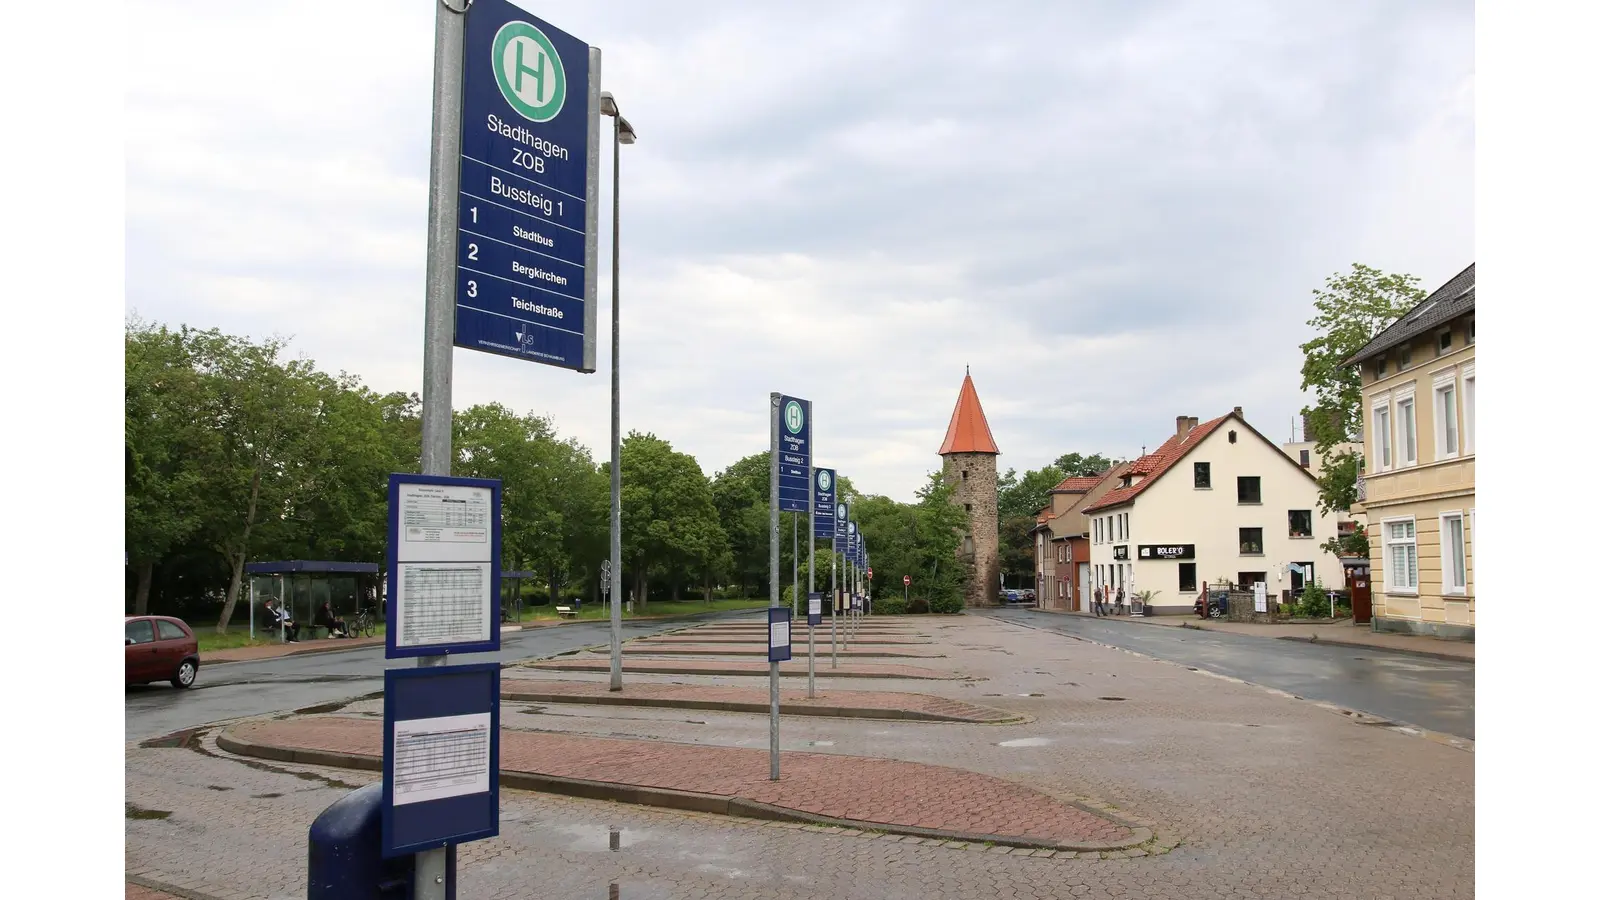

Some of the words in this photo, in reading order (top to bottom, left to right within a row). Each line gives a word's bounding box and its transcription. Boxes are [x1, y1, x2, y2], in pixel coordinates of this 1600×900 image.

[515, 40, 545, 103] H
[487, 113, 568, 161] Stadthagen
[512, 147, 545, 174] ZOB
[490, 176, 552, 216] Bussteig
[557, 201, 563, 216] 1
[470, 206, 478, 224] 1
[513, 225, 554, 248] Stadtbus
[467, 243, 479, 261] 2
[512, 261, 567, 286] Bergkirchen
[467, 280, 478, 298] 3
[511, 296, 564, 319] Teichstraße
[790, 407, 799, 427] H
[784, 434, 805, 445] Stadthagen
[784, 454, 801, 465] Bussteig
